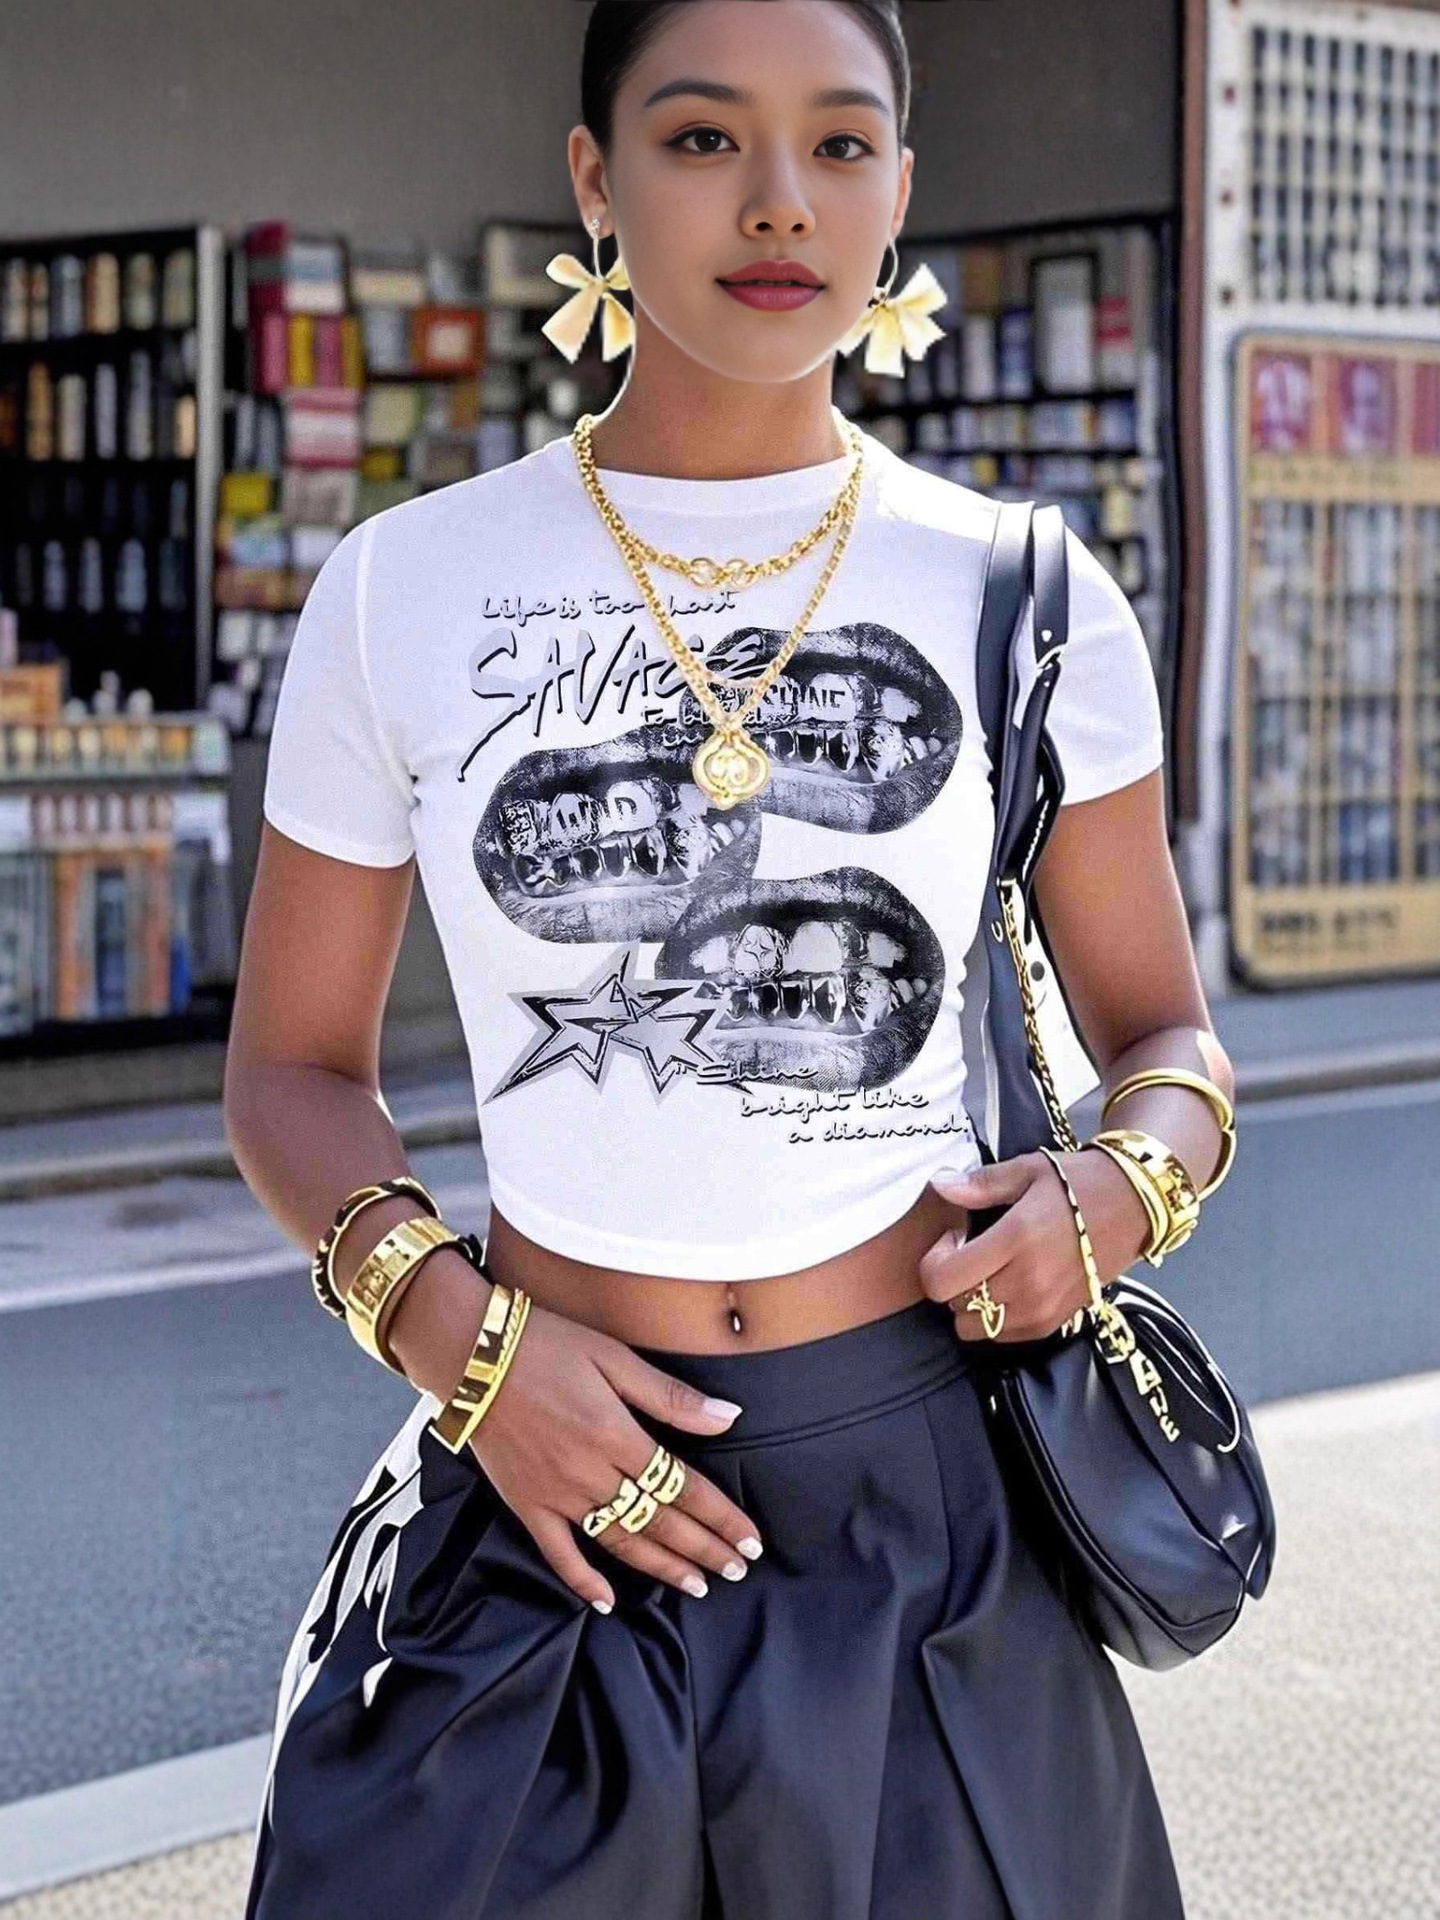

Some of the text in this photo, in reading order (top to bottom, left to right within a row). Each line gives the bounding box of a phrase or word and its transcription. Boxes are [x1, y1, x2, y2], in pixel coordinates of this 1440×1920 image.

[482, 589, 741, 627] Life is too hort
[740, 1087, 930, 1123] bright like
[788, 1129, 814, 1144] a
